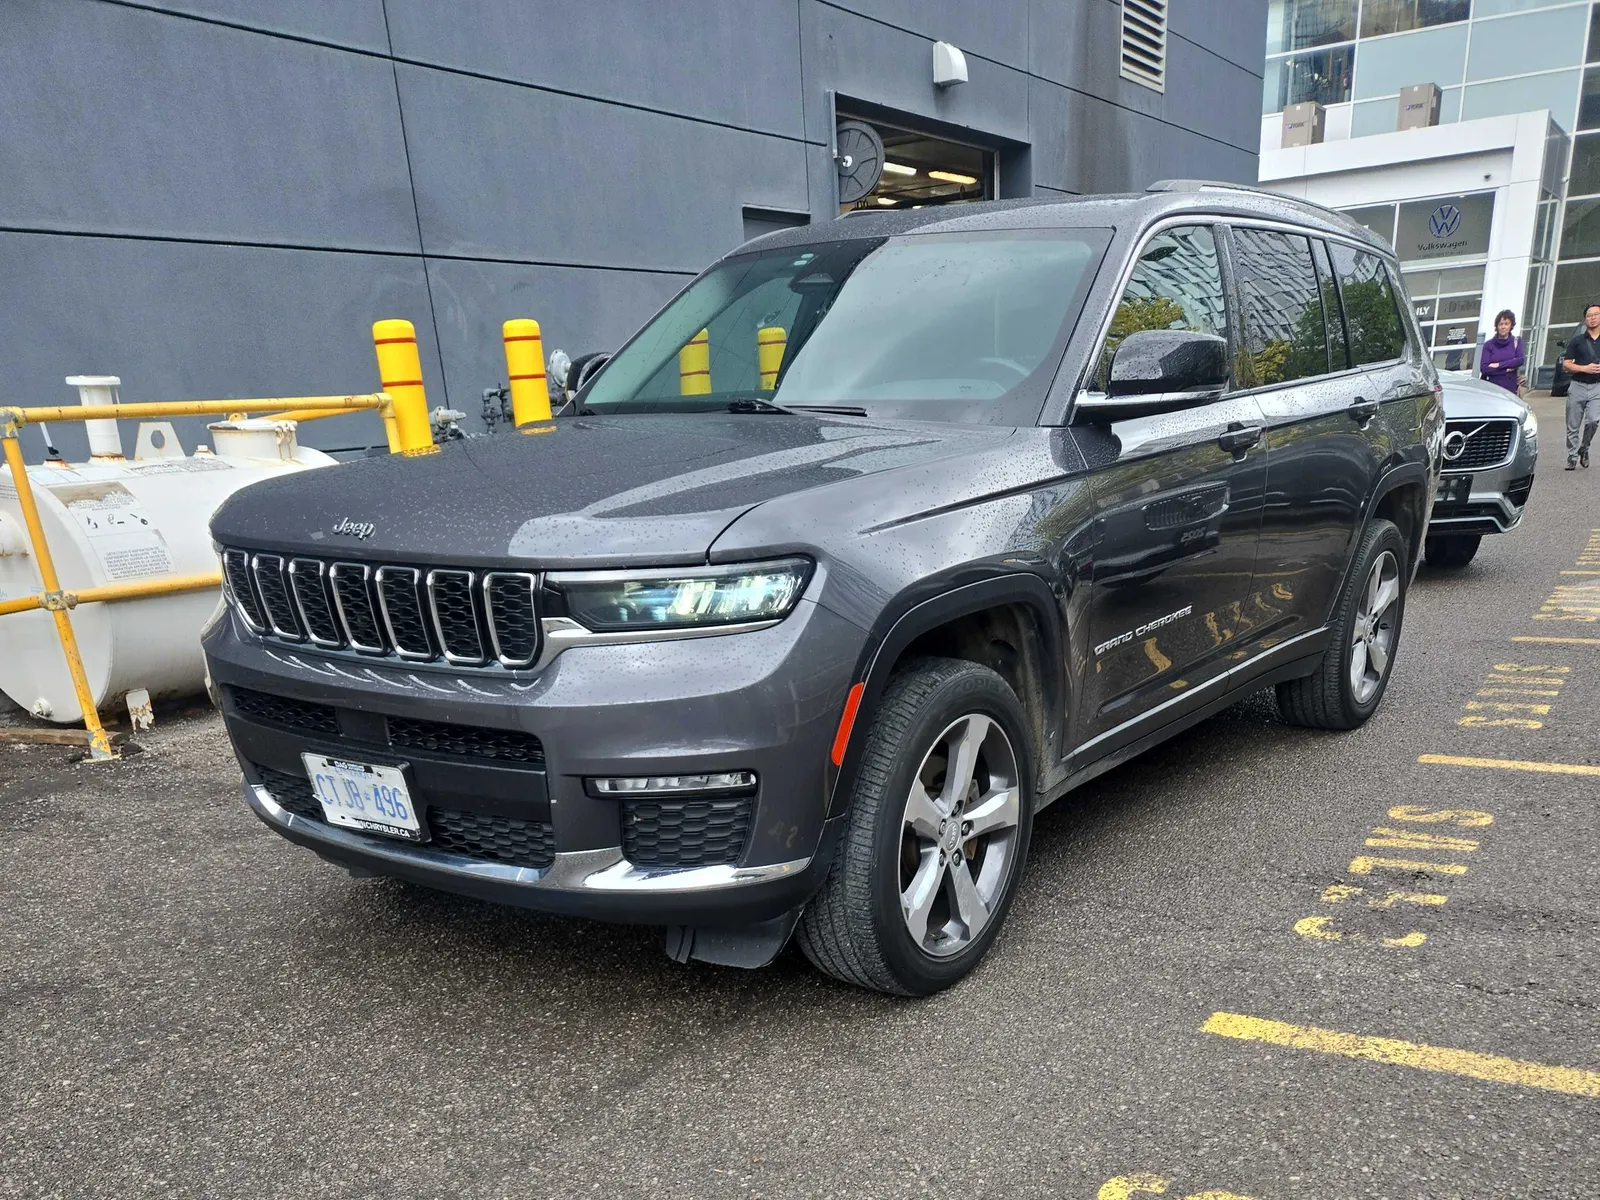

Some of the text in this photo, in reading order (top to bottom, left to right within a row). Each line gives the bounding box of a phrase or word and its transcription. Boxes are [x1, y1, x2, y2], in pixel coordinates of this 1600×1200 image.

[1417, 239, 1468, 251] Volkswagen
[331, 517, 376, 541] Jeep
[1094, 605, 1193, 656] GRAND CHEROKEE
[373, 784, 408, 820] 496
[358, 819, 410, 838] NCHRYSLER.CA
